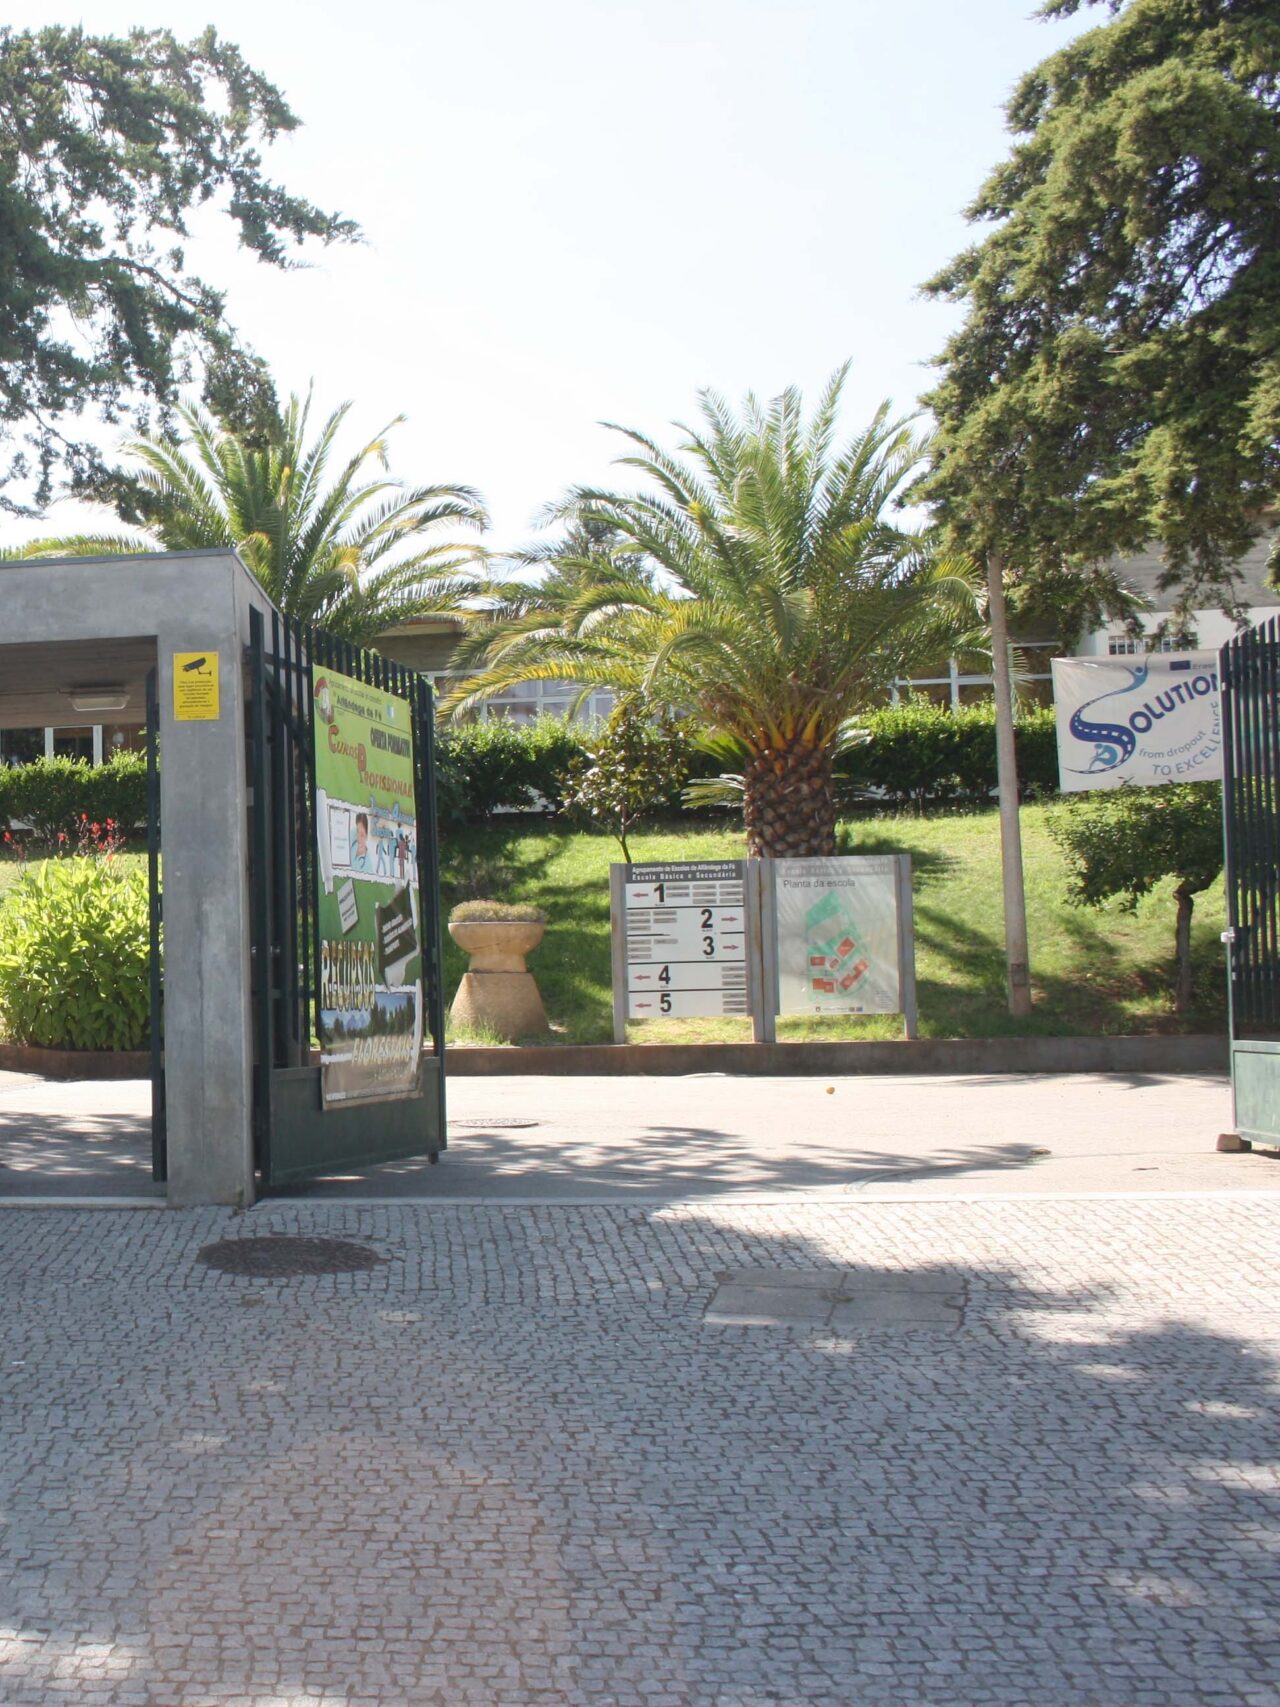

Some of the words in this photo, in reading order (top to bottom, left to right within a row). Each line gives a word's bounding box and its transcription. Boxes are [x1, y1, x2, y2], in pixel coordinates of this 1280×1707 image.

[1139, 747, 1164, 759] from
[1167, 731, 1206, 758] dropout
[1152, 764, 1172, 776] TO
[654, 883, 665, 903] 1
[783, 880, 811, 889] Planta
[814, 879, 825, 888] da
[826, 878, 856, 888] escola
[701, 908, 713, 929] 2
[703, 935, 715, 956] 3
[321, 938, 375, 1012] RECURSOS
[658, 965, 671, 985] 4
[660, 993, 672, 1013] 5
